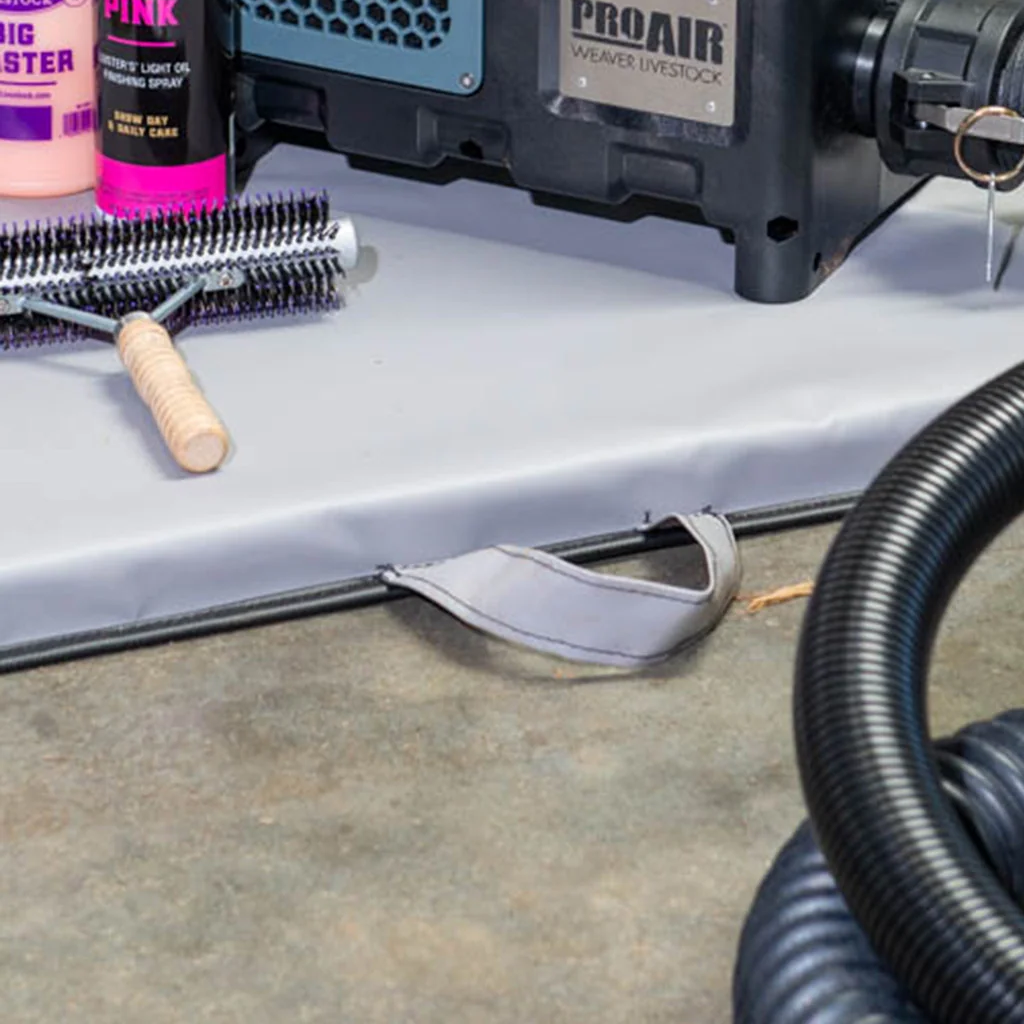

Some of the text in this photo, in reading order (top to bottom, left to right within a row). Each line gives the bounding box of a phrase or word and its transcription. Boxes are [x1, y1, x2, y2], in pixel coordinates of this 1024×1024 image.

[0, 49, 74, 74] STER
[140, 62, 172, 74] LIGHT
[571, 43, 723, 86] WEAVER LIVESTOCK
[148, 77, 184, 90] SPRAY
[146, 115, 169, 126] DAY
[116, 123, 145, 137] DAILY
[149, 127, 179, 138] CARE
